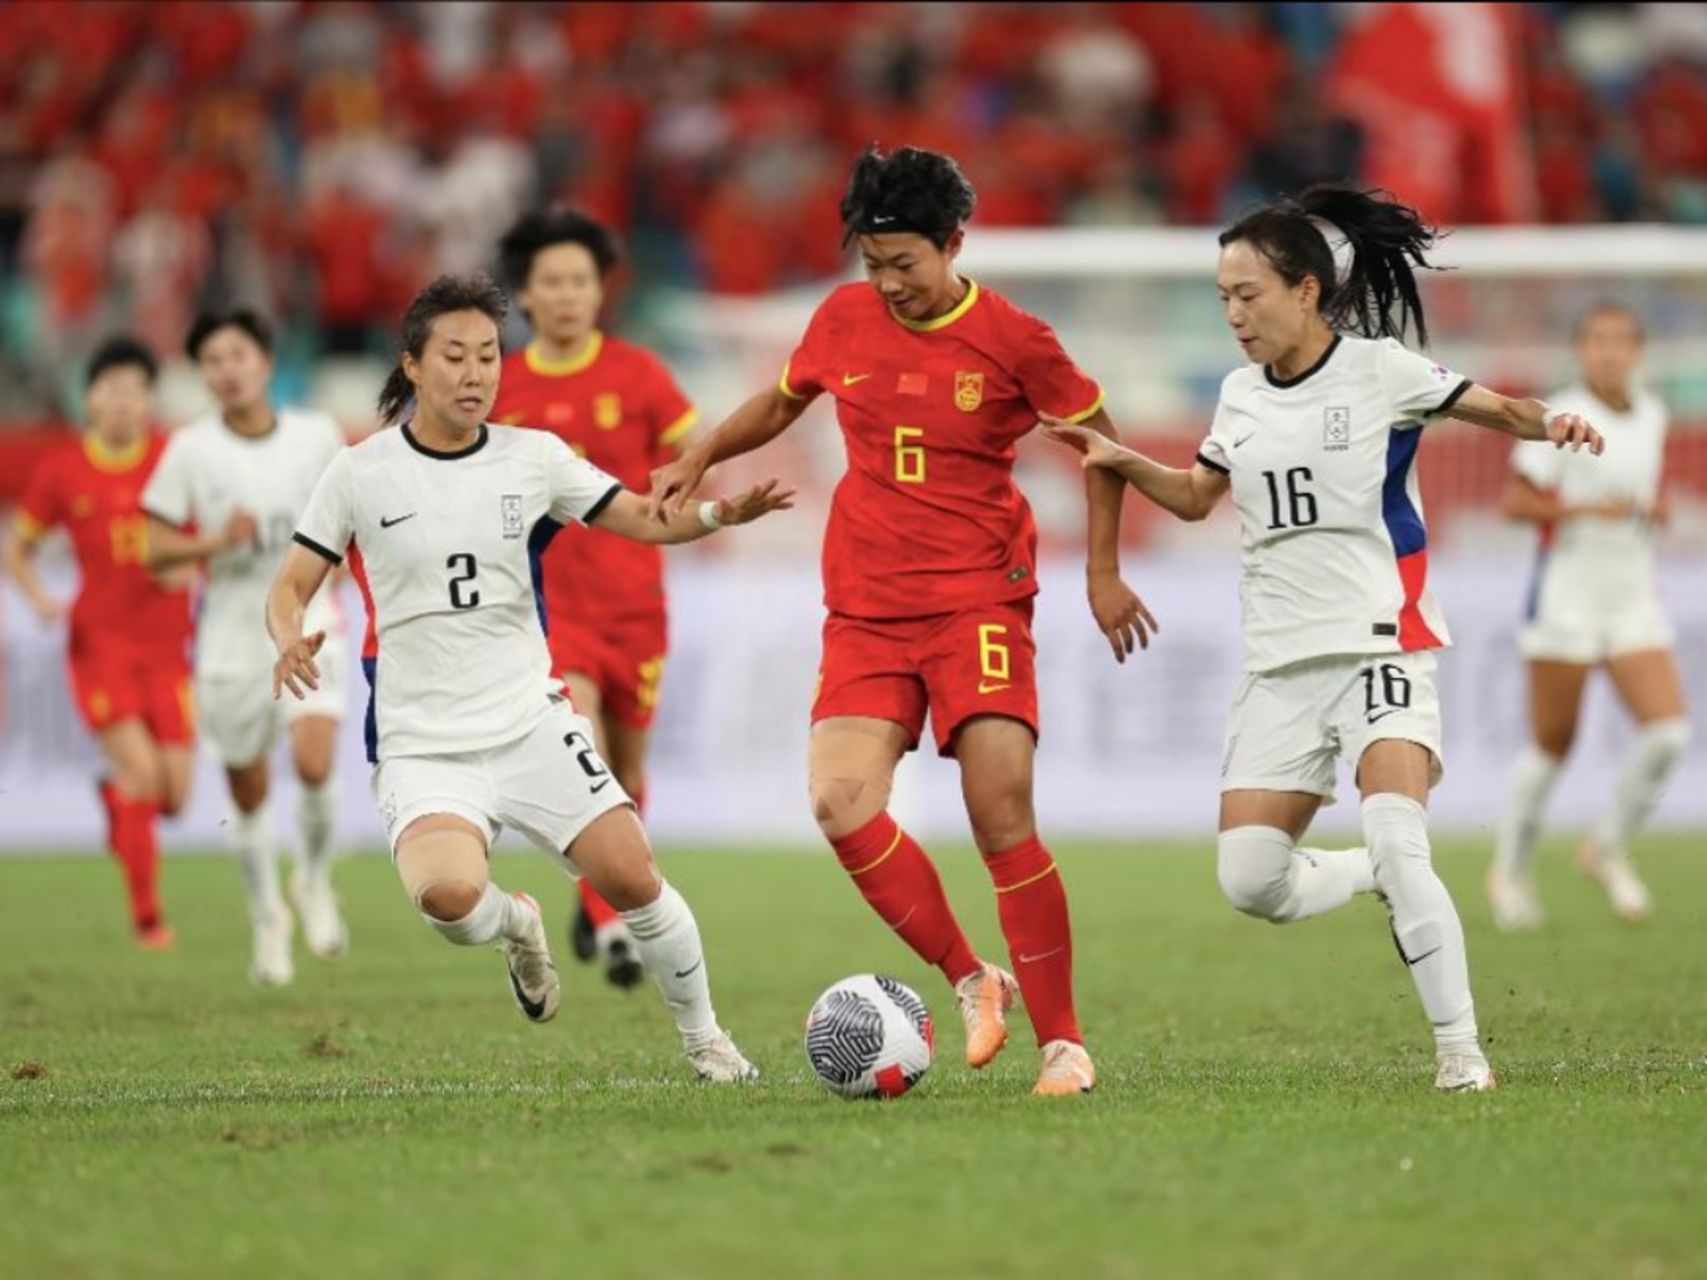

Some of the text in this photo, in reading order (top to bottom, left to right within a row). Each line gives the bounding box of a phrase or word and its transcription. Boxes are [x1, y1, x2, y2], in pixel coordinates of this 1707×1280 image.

[895, 425, 925, 482] 6
[1262, 466, 1318, 529] 16
[447, 553, 480, 609] 2
[978, 624, 1010, 679] 6
[1360, 663, 1411, 710] 16
[563, 731, 607, 777] 2
